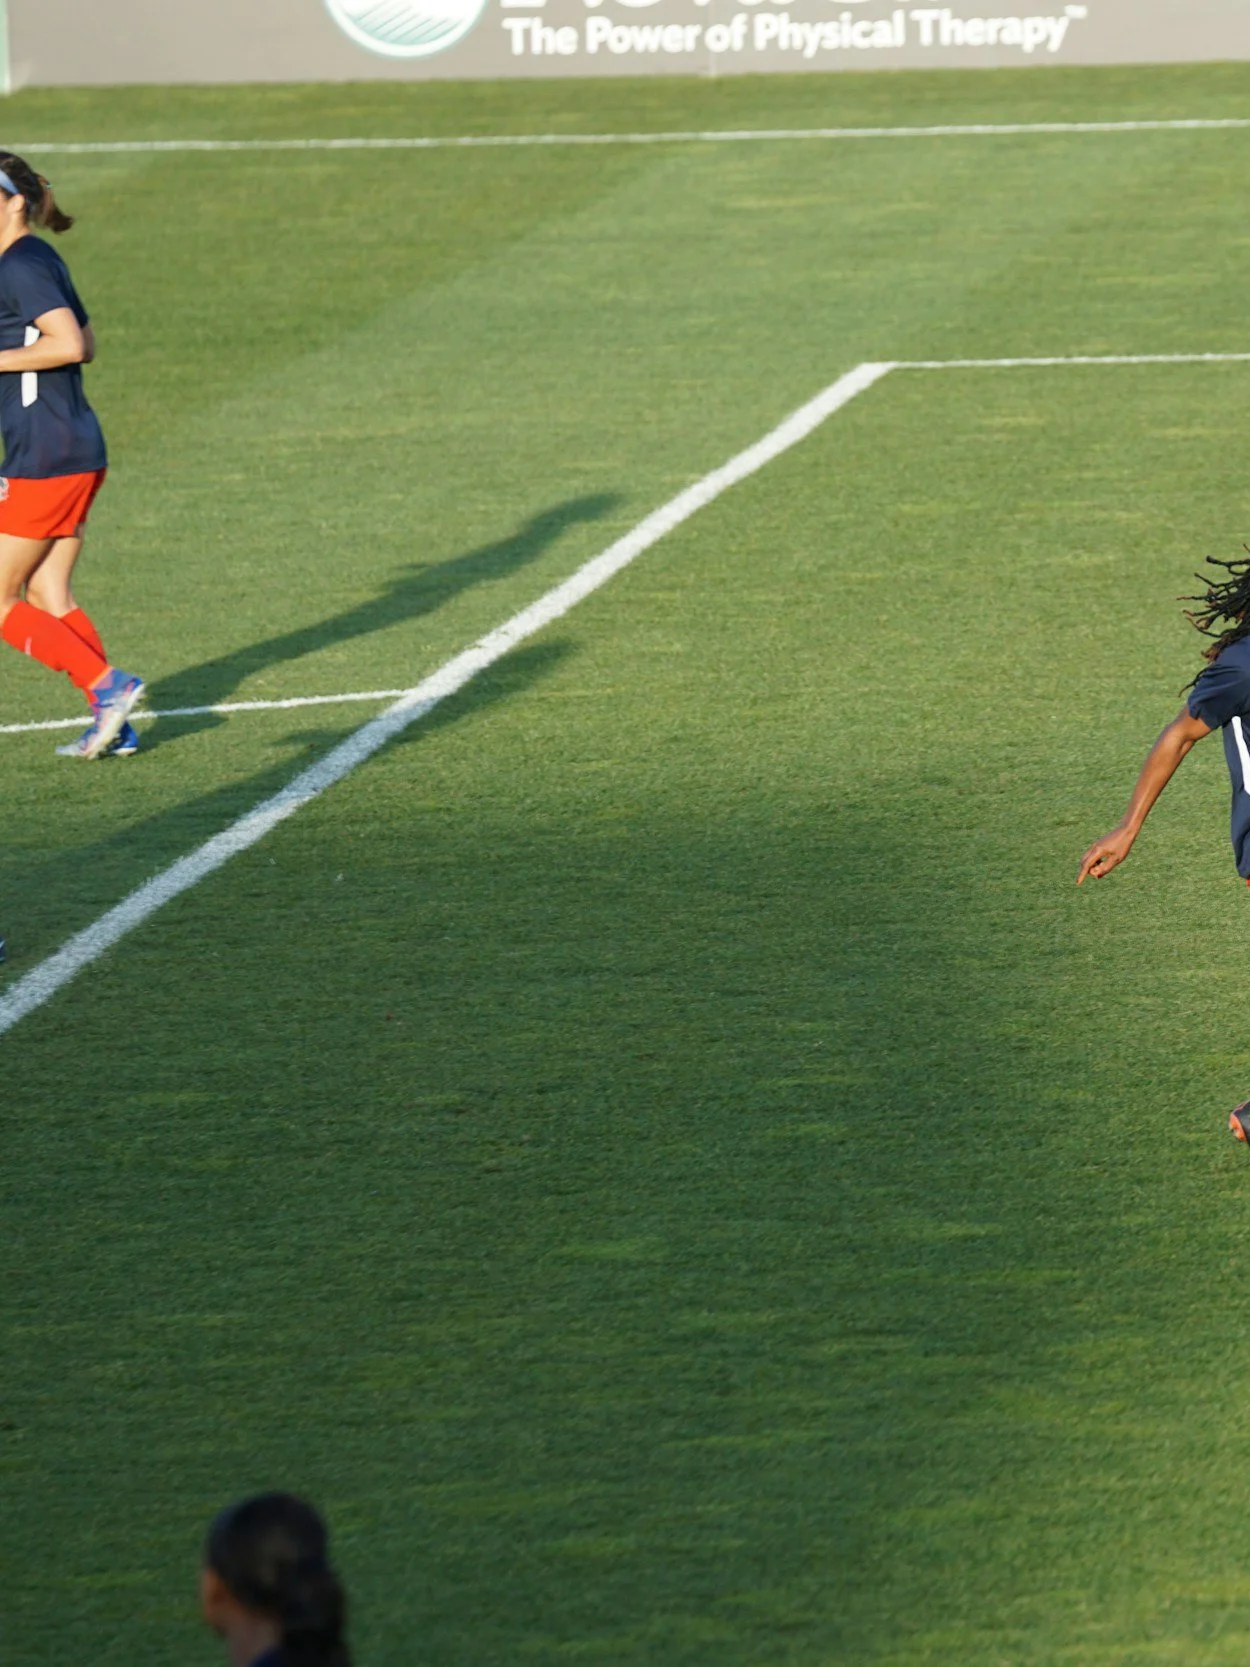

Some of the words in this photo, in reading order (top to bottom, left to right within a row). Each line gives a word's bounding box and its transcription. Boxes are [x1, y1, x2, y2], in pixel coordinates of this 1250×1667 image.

[502, 17, 578, 55] The
[585, 16, 702, 54] Power
[704, 12, 748, 53] of
[754, 9, 905, 58] Physical
